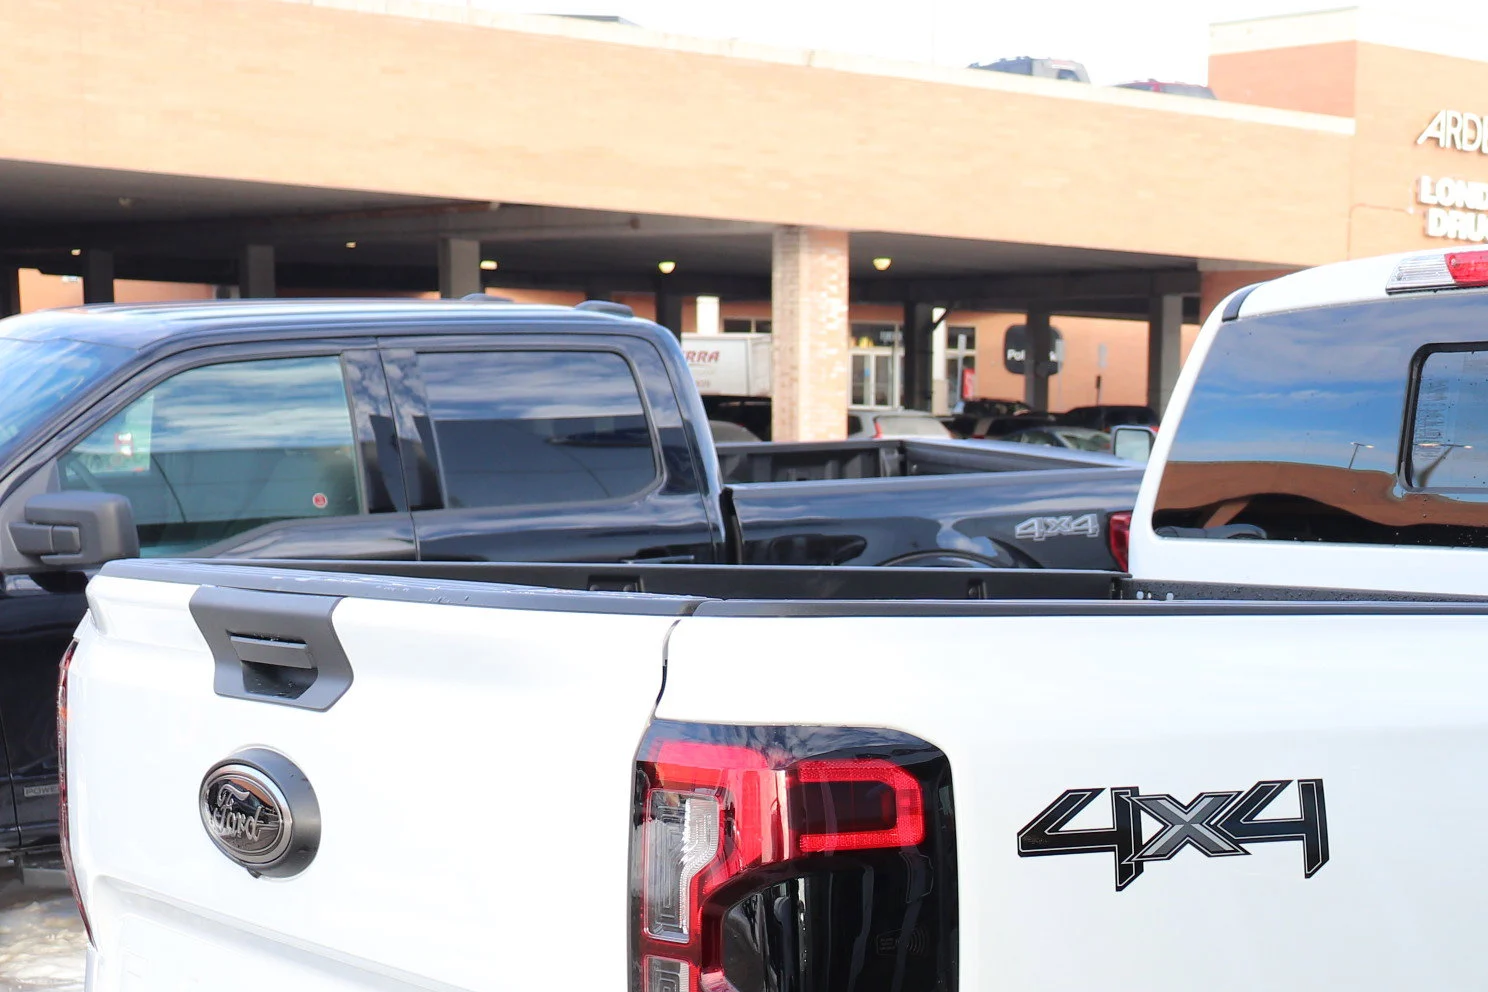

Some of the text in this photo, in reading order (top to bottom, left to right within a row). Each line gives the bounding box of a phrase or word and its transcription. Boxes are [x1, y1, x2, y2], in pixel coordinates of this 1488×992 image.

[684, 350, 720, 363] RRA
[1007, 349, 1026, 361] Pol
[25, 785, 60, 796] POWE
[212, 783, 262, 842] Ford
